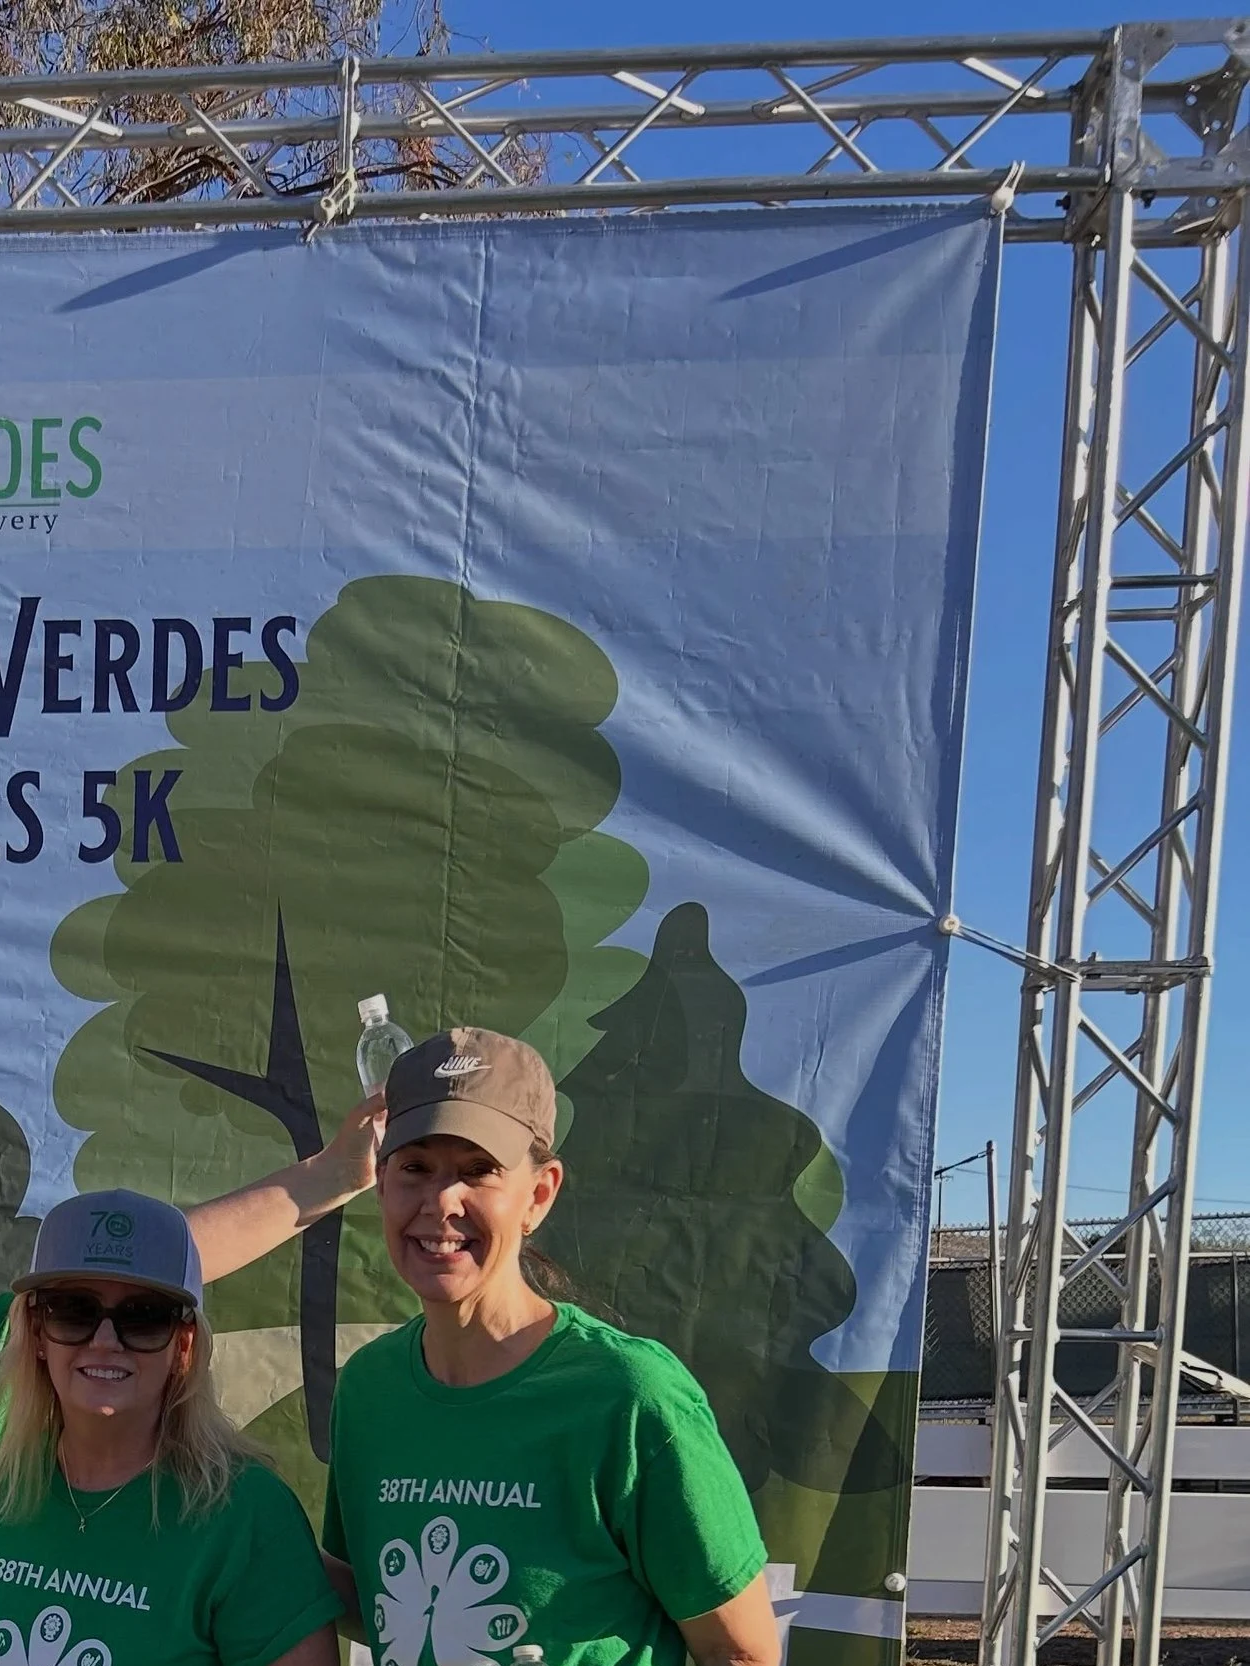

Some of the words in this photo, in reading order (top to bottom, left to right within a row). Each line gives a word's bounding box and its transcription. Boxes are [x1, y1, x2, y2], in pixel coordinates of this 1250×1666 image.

[78, 770, 184, 863] 5K
[443, 1055, 482, 1070] NIKE
[85, 1242, 134, 1259] YEARS
[379, 1479, 426, 1503] 38TH
[428, 1480, 542, 1509] ANNUAL
[44, 1567, 151, 1611] ANNUAL
